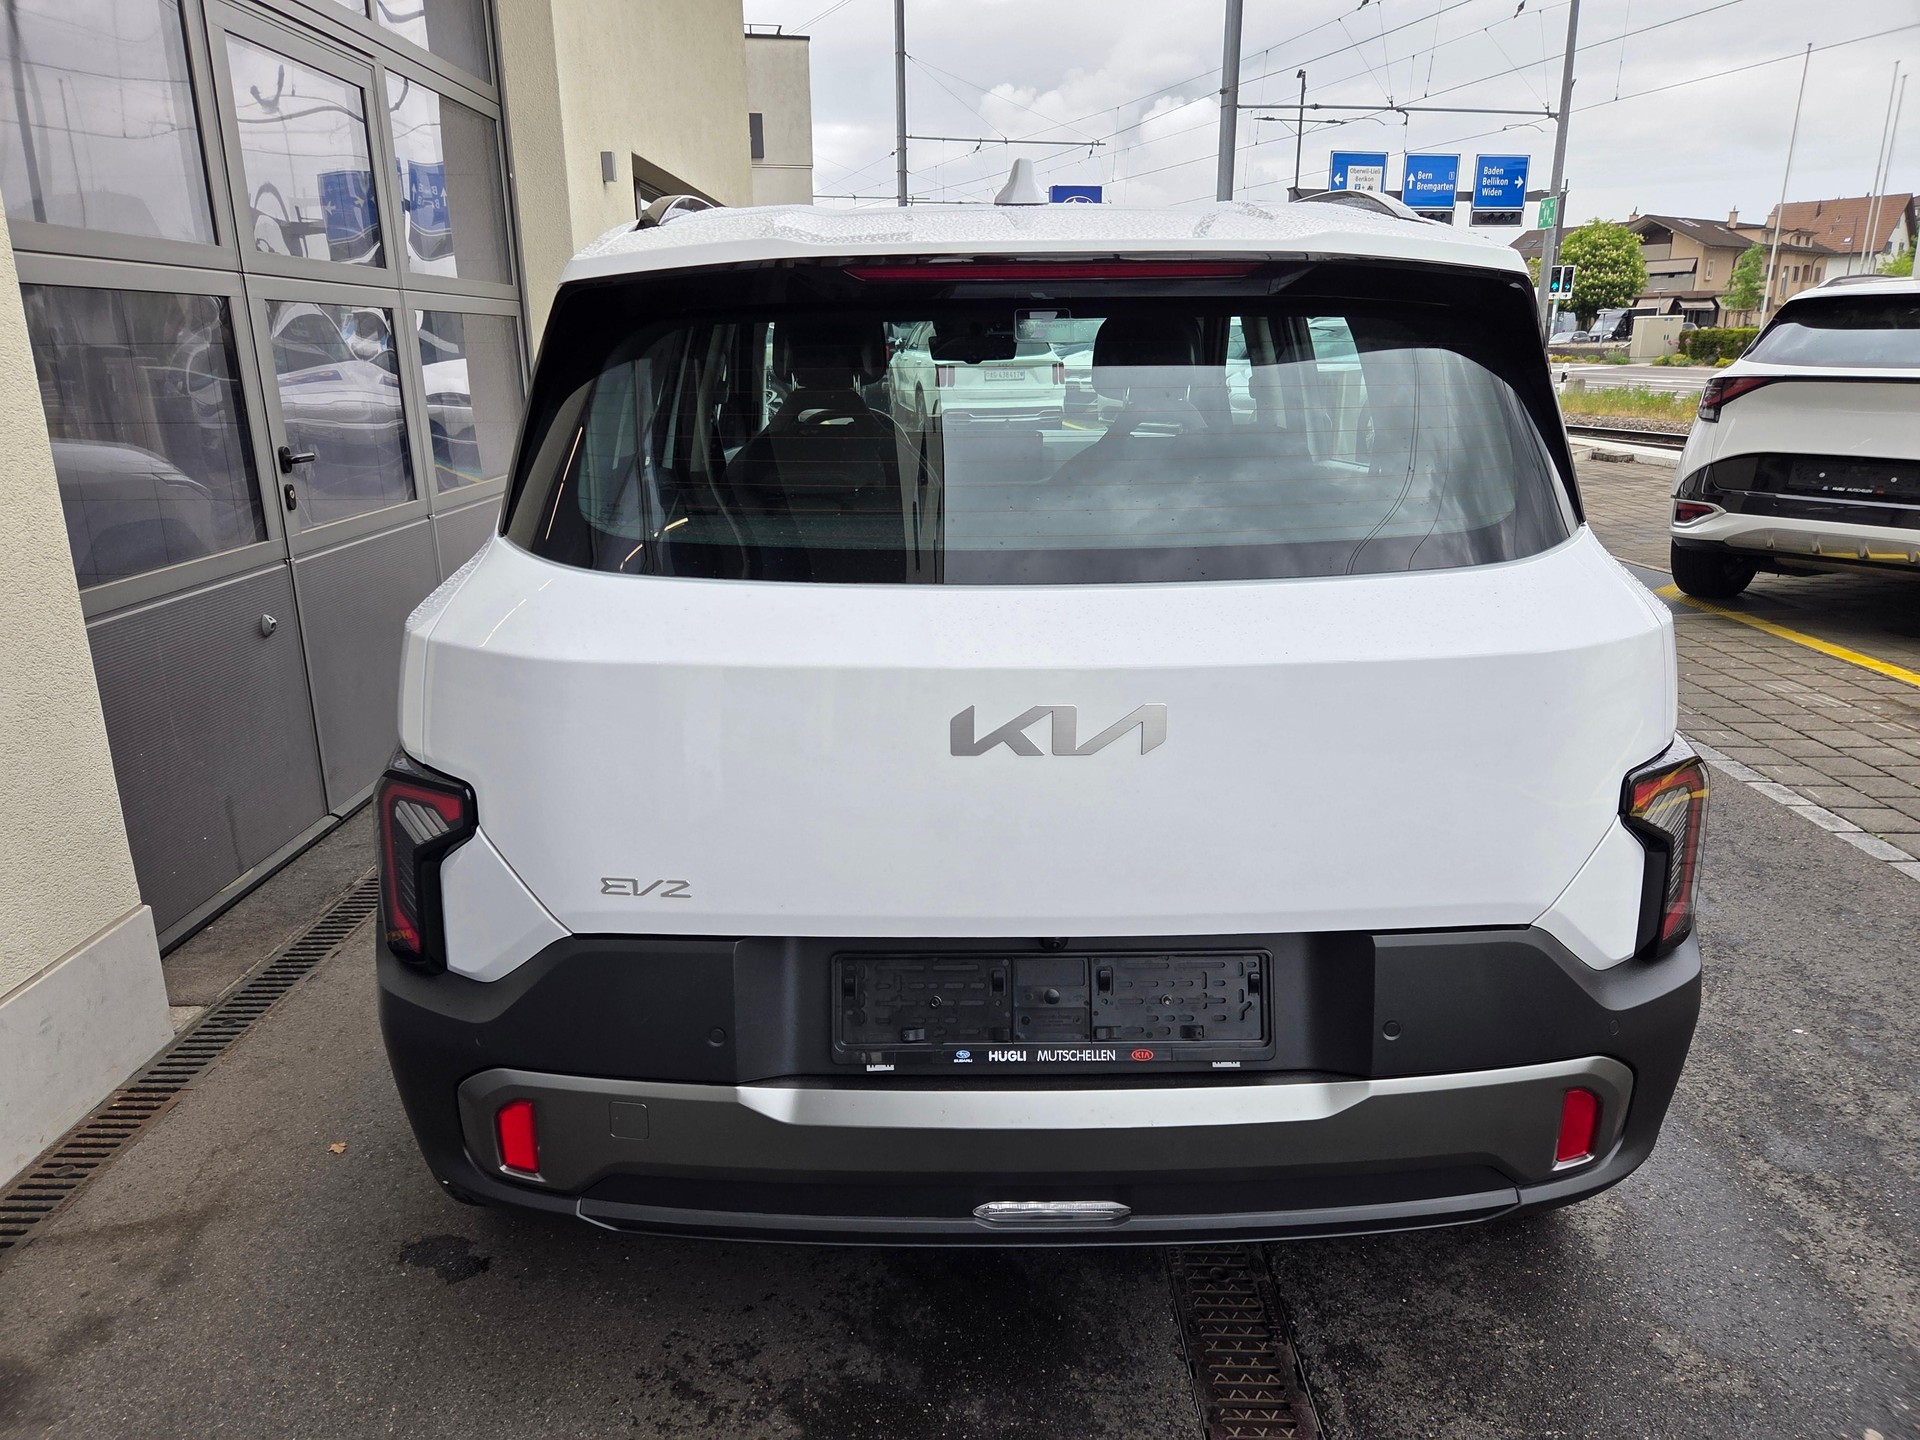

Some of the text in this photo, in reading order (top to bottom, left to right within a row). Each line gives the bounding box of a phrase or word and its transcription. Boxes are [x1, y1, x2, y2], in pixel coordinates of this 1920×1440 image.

[1417, 171, 1433, 180] Bern
[1483, 166, 1504, 175] Baden
[1482, 177, 1509, 186] Bellikon
[1416, 182, 1454, 192] Bremgarten
[1481, 187, 1503, 196] Widen
[950, 702, 1167, 757] KIA
[600, 877, 693, 899] EV2
[988, 1050, 1116, 1062] HÜGLI MUTSCHELLEN
[1134, 1050, 1152, 1061] KIA
